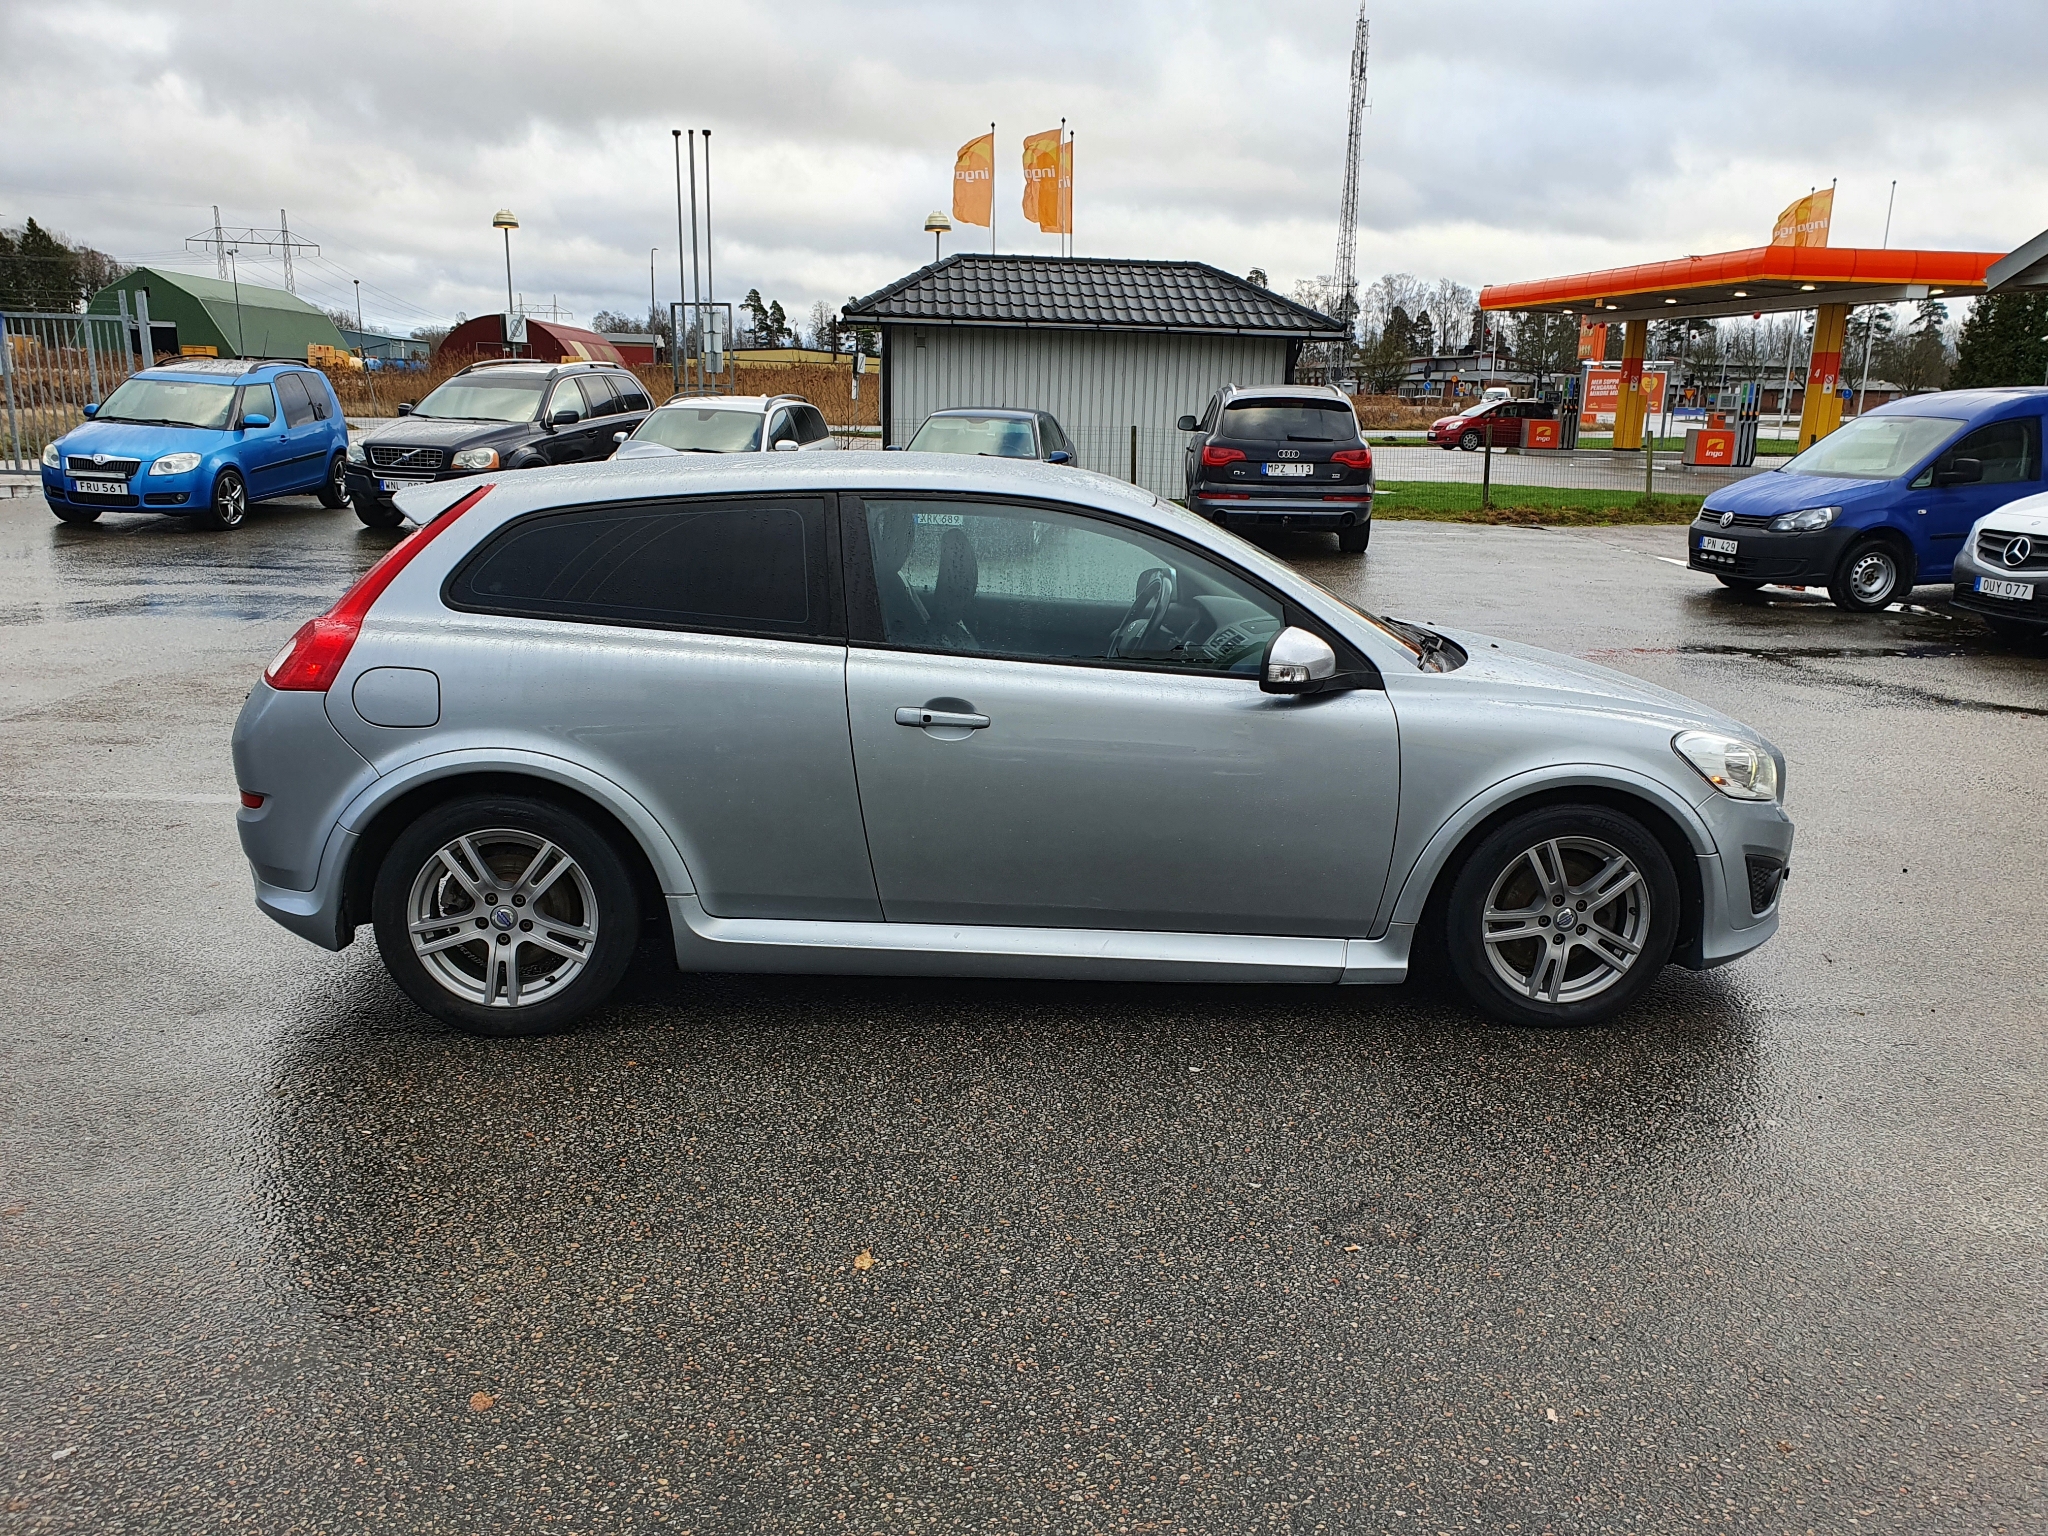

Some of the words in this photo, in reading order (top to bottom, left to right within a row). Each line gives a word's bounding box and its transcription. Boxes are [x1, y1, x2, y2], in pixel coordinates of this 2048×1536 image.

[1814, 368, 1821, 379] 4
[1267, 464, 1286, 474] MPZ
[1294, 464, 1312, 474] 113
[80, 481, 100, 493] FRU
[102, 483, 123, 494] 561
[384, 481, 401, 491] WNL
[941, 514, 960, 524] 689
[1702, 538, 1717, 550] LPN
[1720, 540, 1736, 553] 429
[1983, 579, 2003, 594] OUY
[2005, 582, 2029, 597] 077
